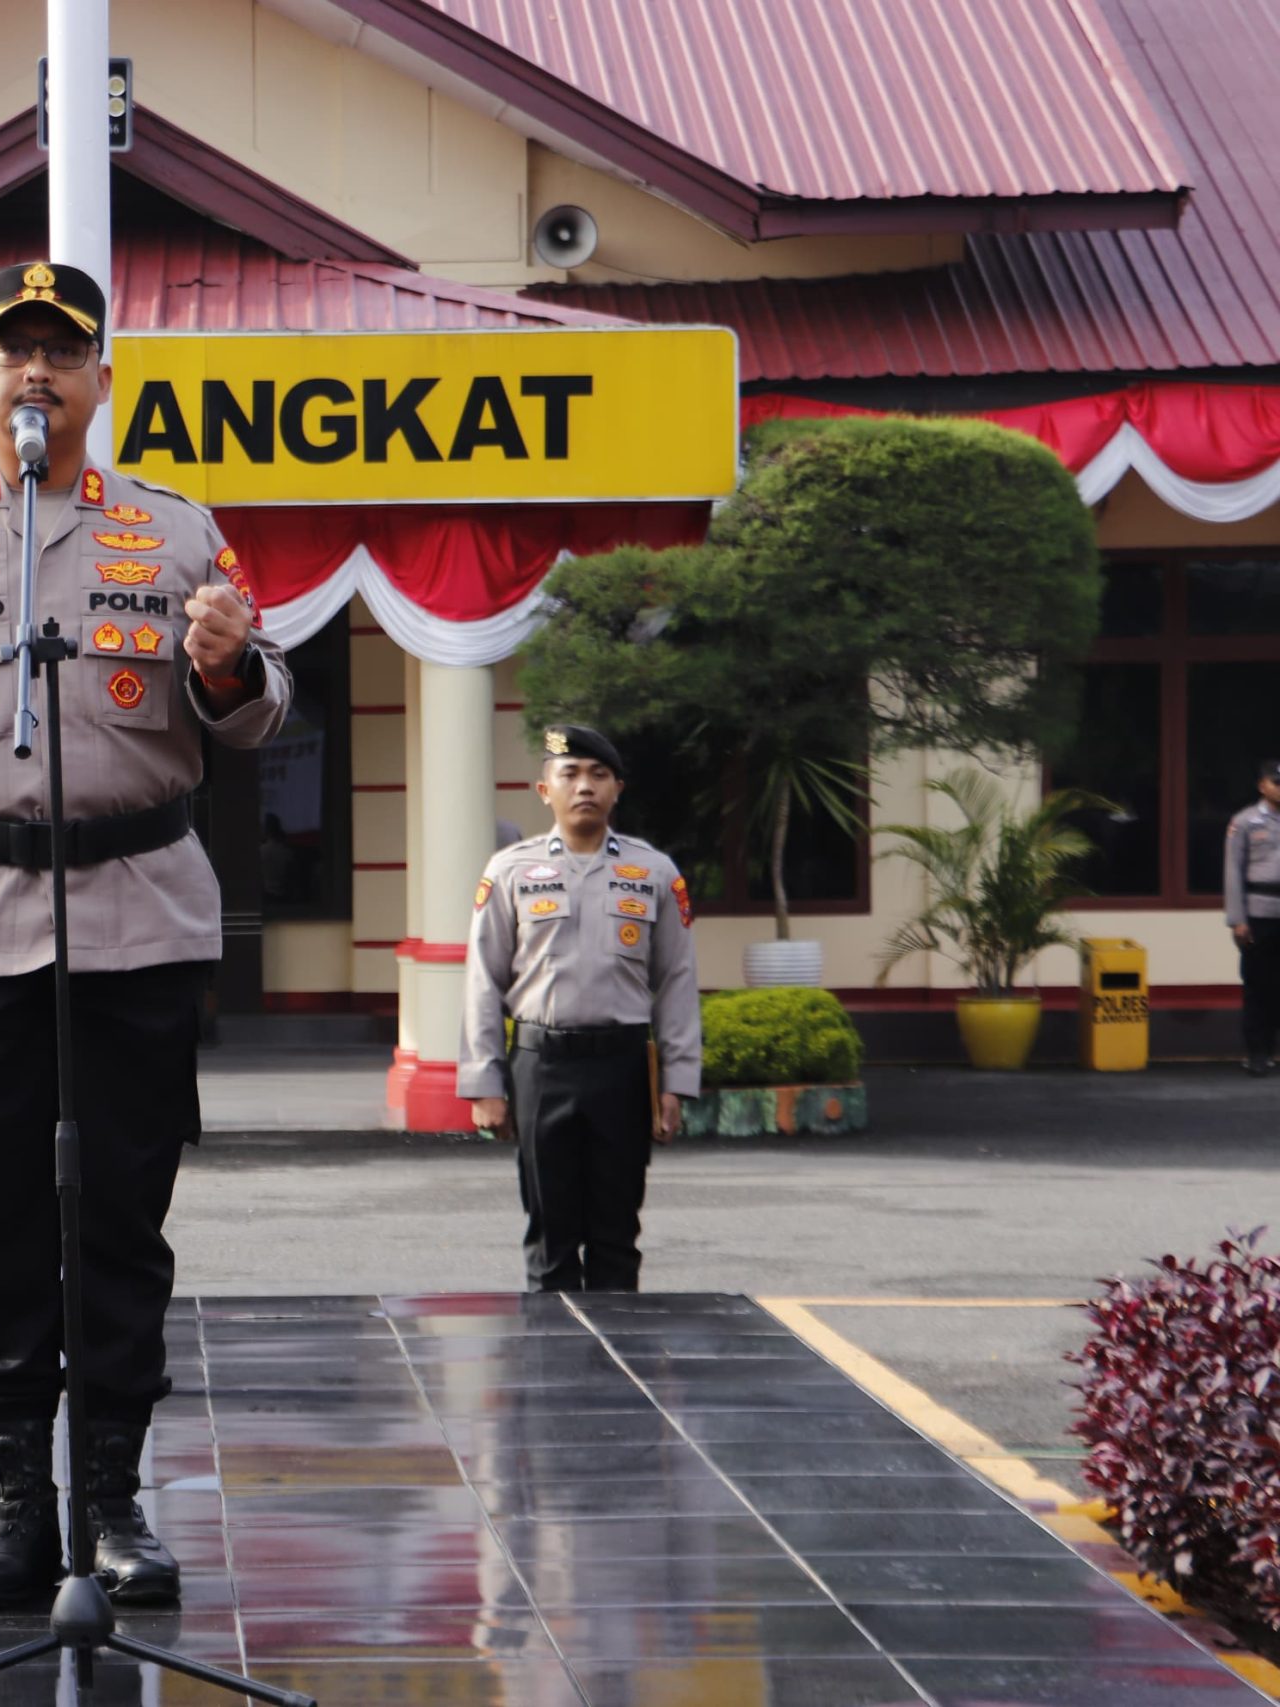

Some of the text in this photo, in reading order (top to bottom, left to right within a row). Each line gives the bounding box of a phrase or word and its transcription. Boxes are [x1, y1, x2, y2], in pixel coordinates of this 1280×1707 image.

[117, 374, 593, 465] ANGKAT
[89, 591, 168, 617] POLRI
[608, 881, 654, 896] POLRI
